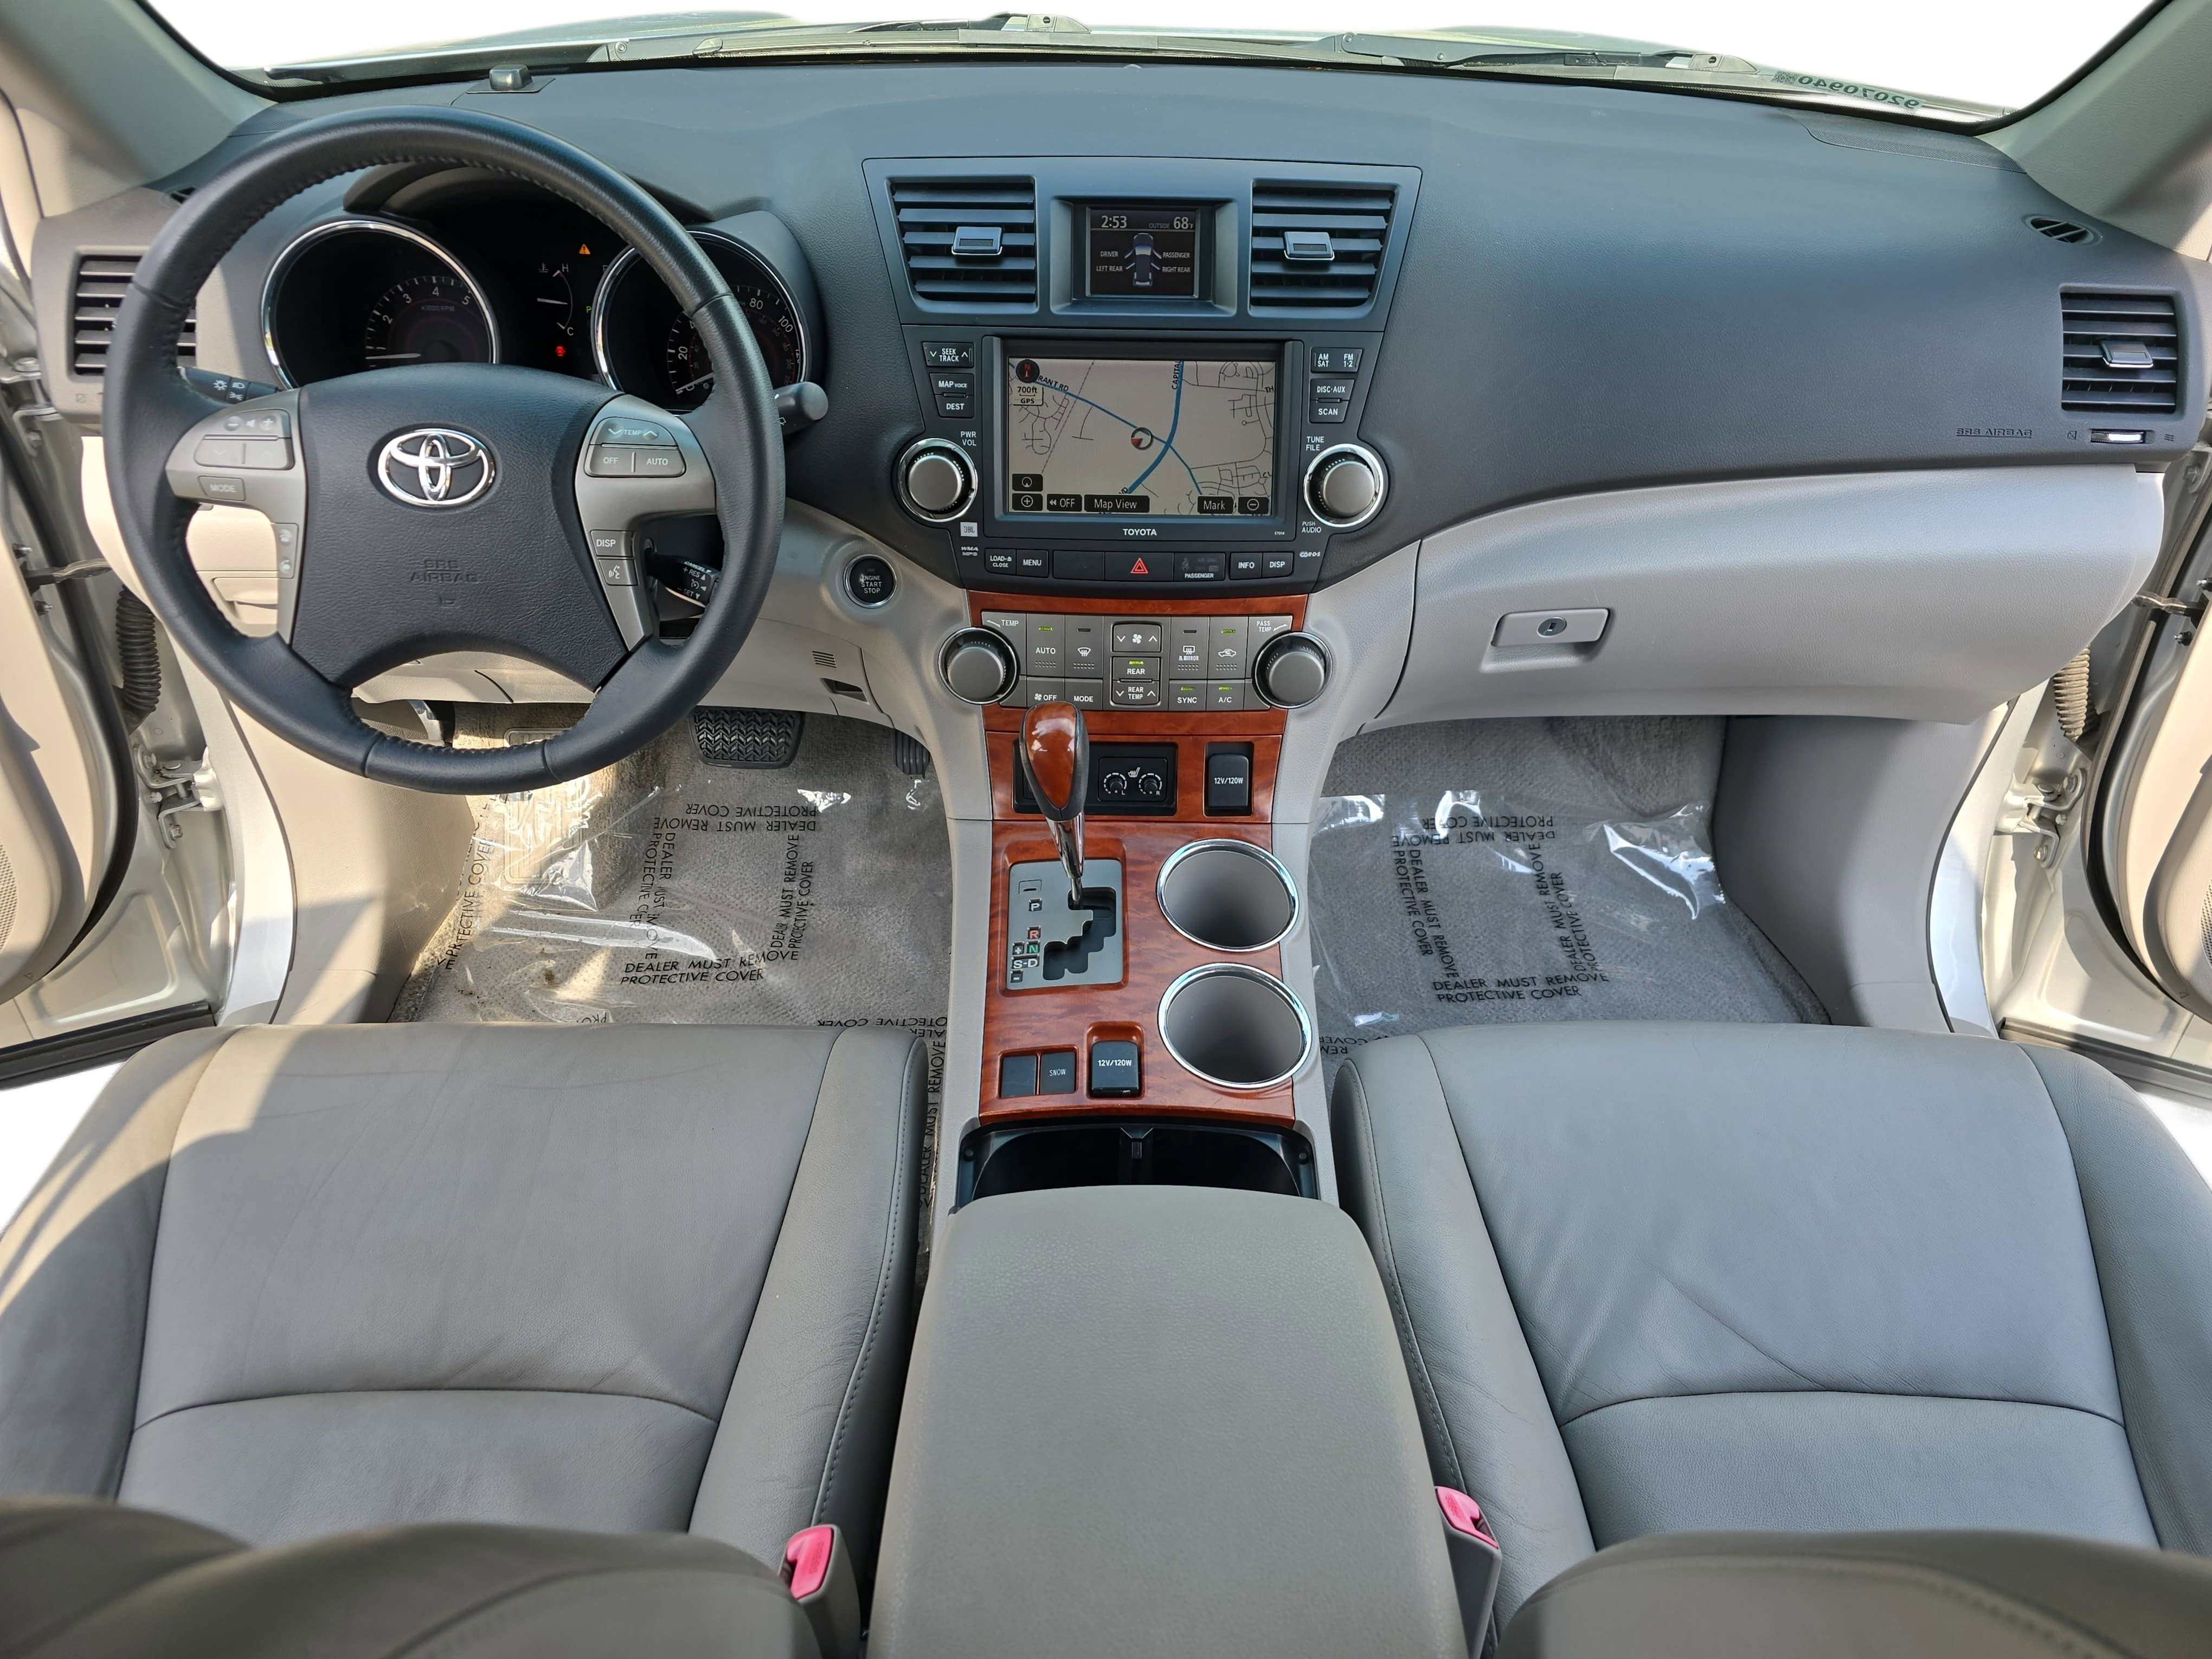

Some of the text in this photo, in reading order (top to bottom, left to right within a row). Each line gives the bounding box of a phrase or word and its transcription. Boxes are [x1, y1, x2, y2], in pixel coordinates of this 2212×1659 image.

[1101, 215, 1127, 228] 2:53
[562, 263, 569, 272] H
[432, 286, 440, 297] 4
[403, 293, 412, 304] 3
[461, 295, 471, 305] 5
[749, 298, 763, 310] 80
[382, 314, 393, 324] 2
[778, 316, 793, 332] 100
[567, 327, 574, 336] C
[678, 346, 688, 360] 20
[1059, 383, 1069, 391] RD
[210, 483, 237, 492] MODE
[1059, 499, 1075, 507] OFF
[1094, 499, 1137, 509] Map View
[1203, 500, 1226, 510] Mark
[596, 539, 616, 547] DISP
[686, 803, 816, 817] PROTECTIVE COVER
[653, 817, 816, 832] DEALER MUST REMOVE
[1472, 815, 1553, 827] PROTECTIVE
[1458, 831, 1495, 843] MUST
[1505, 831, 1555, 841] DEALER
[659, 833, 676, 880] DEALER
[783, 834, 799, 883] REMOVE
[799, 861, 813, 896] COVER
[1551, 871, 1572, 908] COVER
[779, 888, 794, 917] MUST
[1031, 903, 1040, 911] P
[1394, 850, 1433, 956] PROTECTIVE COVER
[1529, 843, 1586, 972] DEALER MUST REMOVE
[1409, 850, 1459, 978] DEALER MUST REMOVE
[1030, 930, 1039, 939] R
[1028, 945, 1039, 953] N
[625, 950, 799, 973] DEALER MUST REMOVE
[620, 968, 764, 985] PROTECTIVE COVER
[1433, 973, 1610, 991] DEALER MUST REMOVE
[1437, 985, 1582, 1003] PROTECTIVE COVER
[928, 1040, 946, 1093] REMOVE
[1049, 1068, 1066, 1077] SNOW
